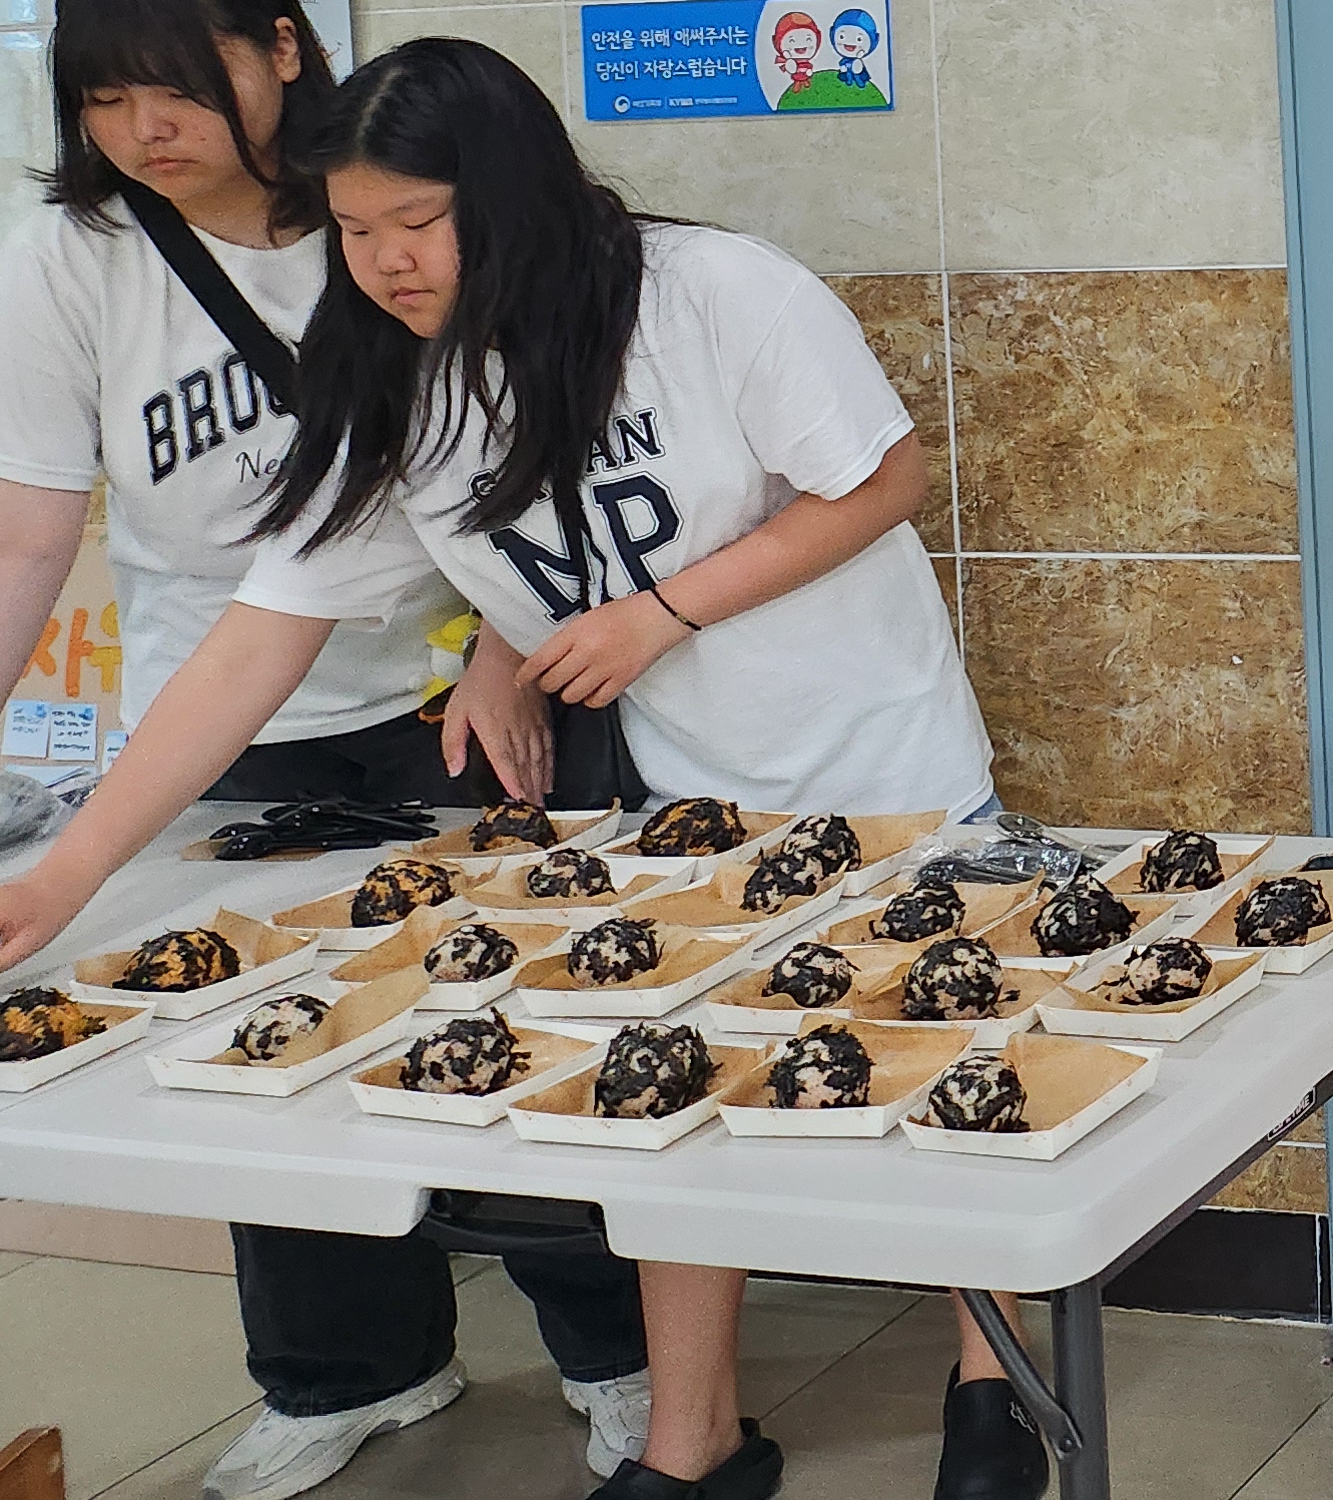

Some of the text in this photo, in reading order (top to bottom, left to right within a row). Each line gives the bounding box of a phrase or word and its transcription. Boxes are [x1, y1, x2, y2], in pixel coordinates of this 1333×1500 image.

[591, 25, 750, 51] 안전을 위해 애써주시는
[596, 56, 748, 82] 당신이 자랑스럽습니다
